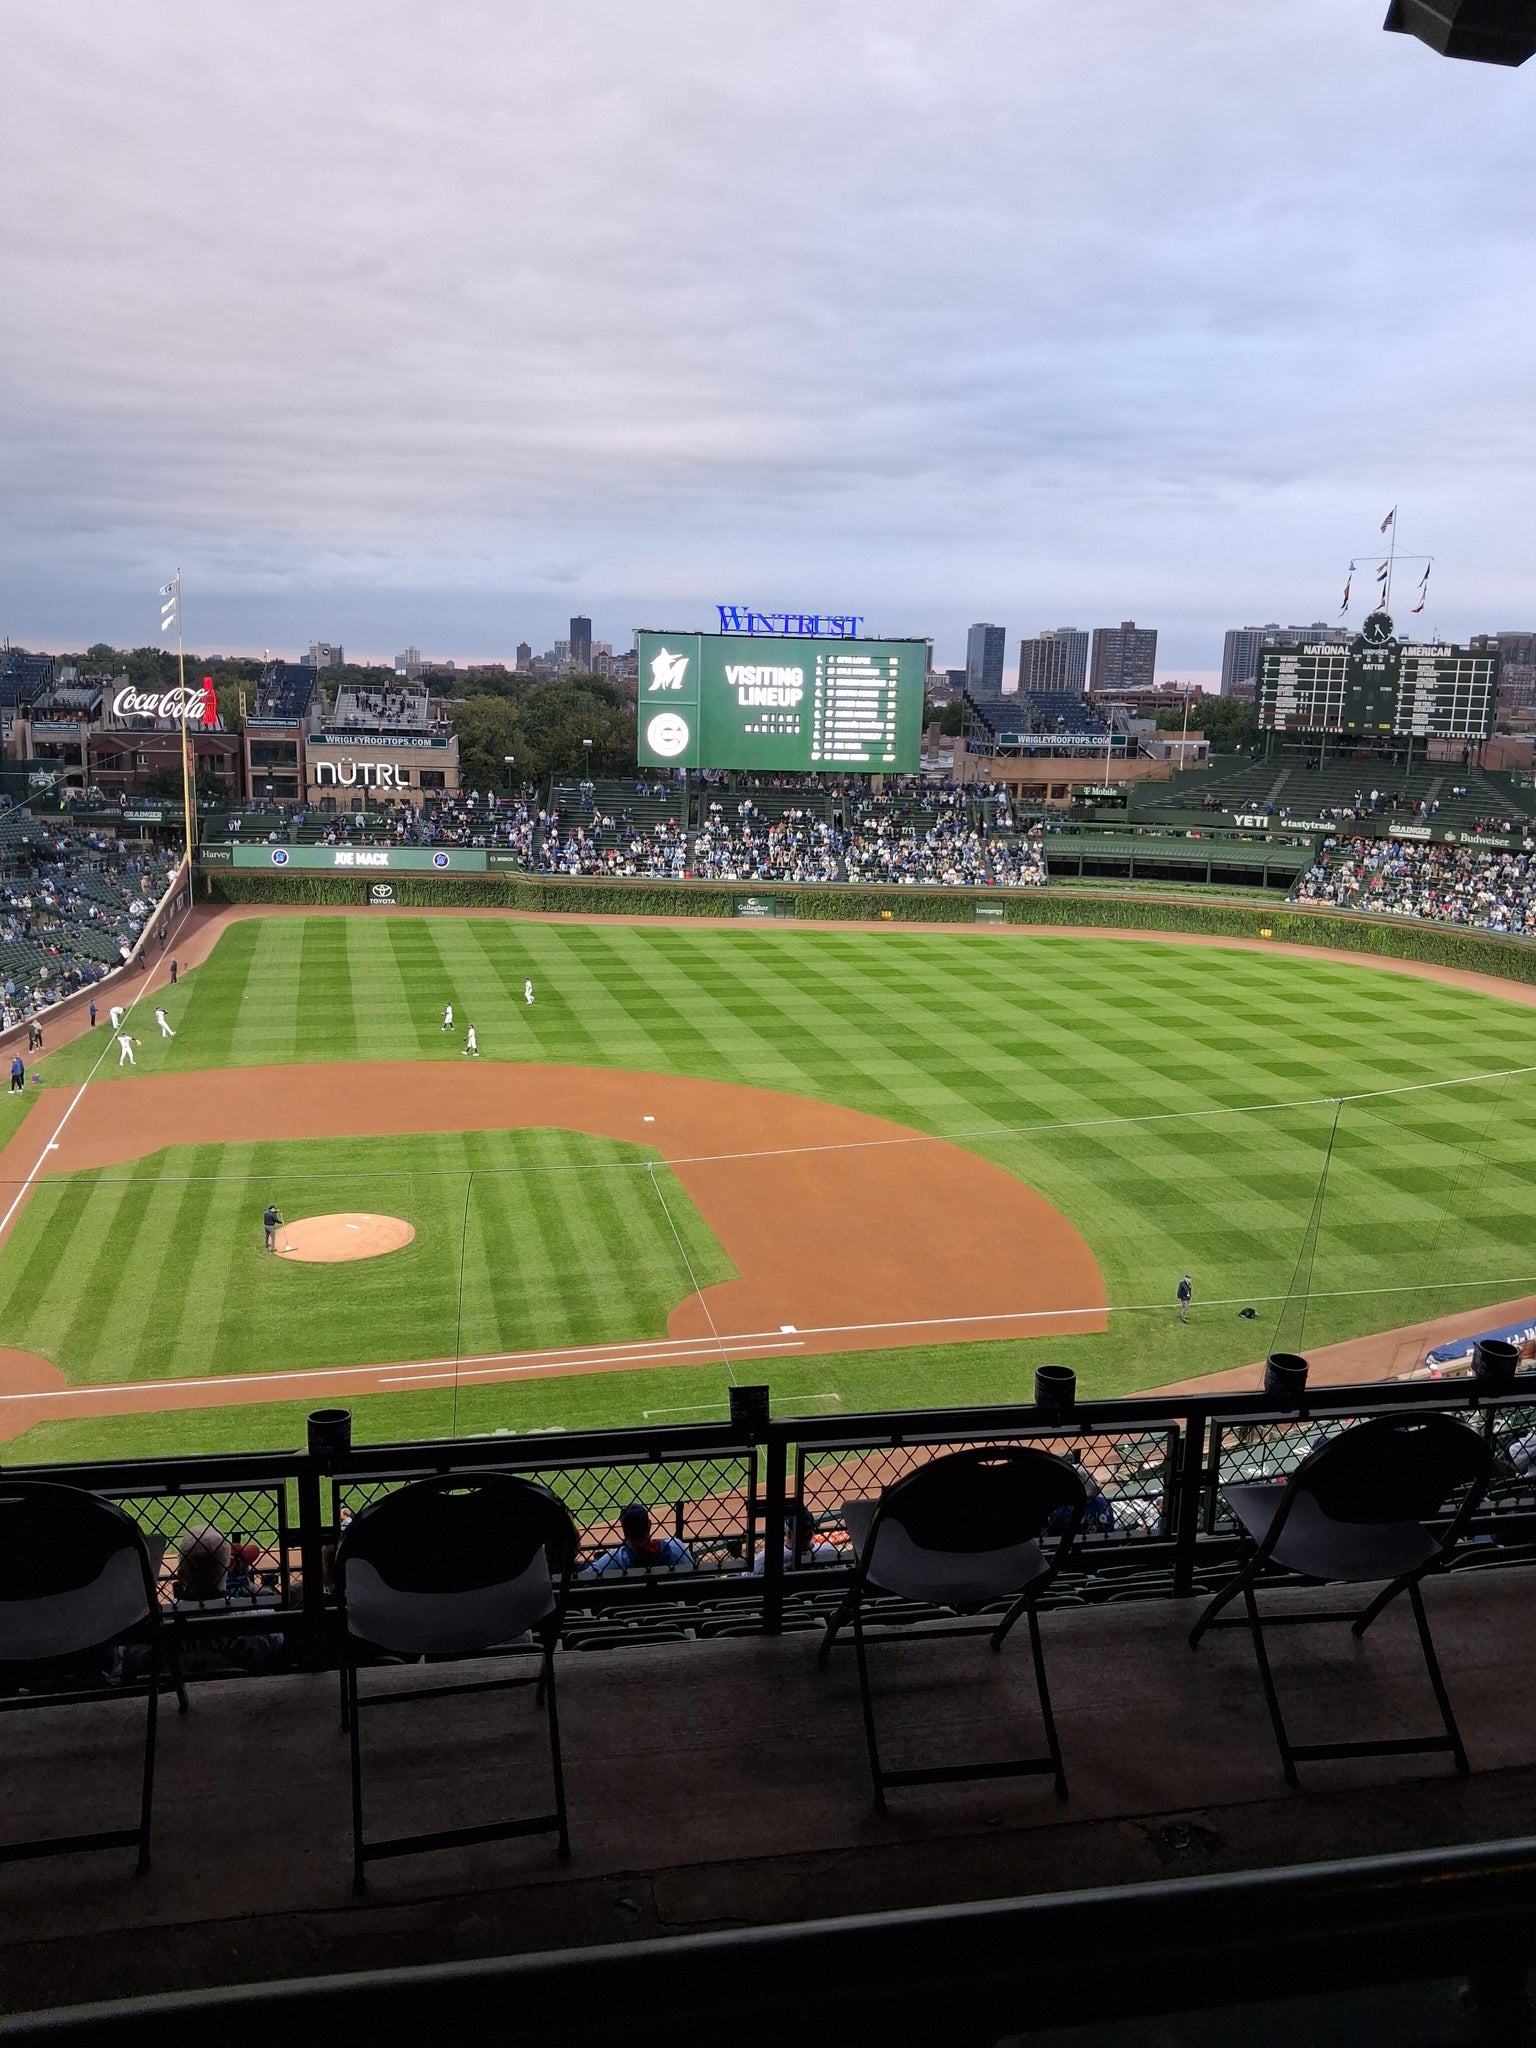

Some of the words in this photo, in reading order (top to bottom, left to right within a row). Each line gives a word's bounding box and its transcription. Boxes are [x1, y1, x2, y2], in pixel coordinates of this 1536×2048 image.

[716, 605, 864, 636] WINTRUST
[1303, 645, 1350, 655] NATIONAL
[1400, 647, 1452, 657] AMERICAN
[725, 665, 803, 687] VISITING
[113, 686, 209, 718] Coca-Cola
[738, 686, 803, 707] LINEUP
[761, 713, 800, 723] MIAMI
[744, 724, 800, 734] MARLINS
[325, 735, 432, 747] WRIGLEYROOFTOPS.COM
[1017, 735, 1110, 744] WRIGLEYROOFTOPS.COM
[317, 757, 410, 786] NÜTRL
[1233, 814, 1269, 828] YETI
[1287, 820, 1336, 830] tastytrade
[1388, 824, 1432, 836] GRAINGER
[1460, 832, 1510, 846] Budweiser
[202, 850, 231, 860] Harvey
[334, 852, 354, 866] JOE
[356, 852, 389, 866] MACK
[737, 904, 769, 912] Gallagher
